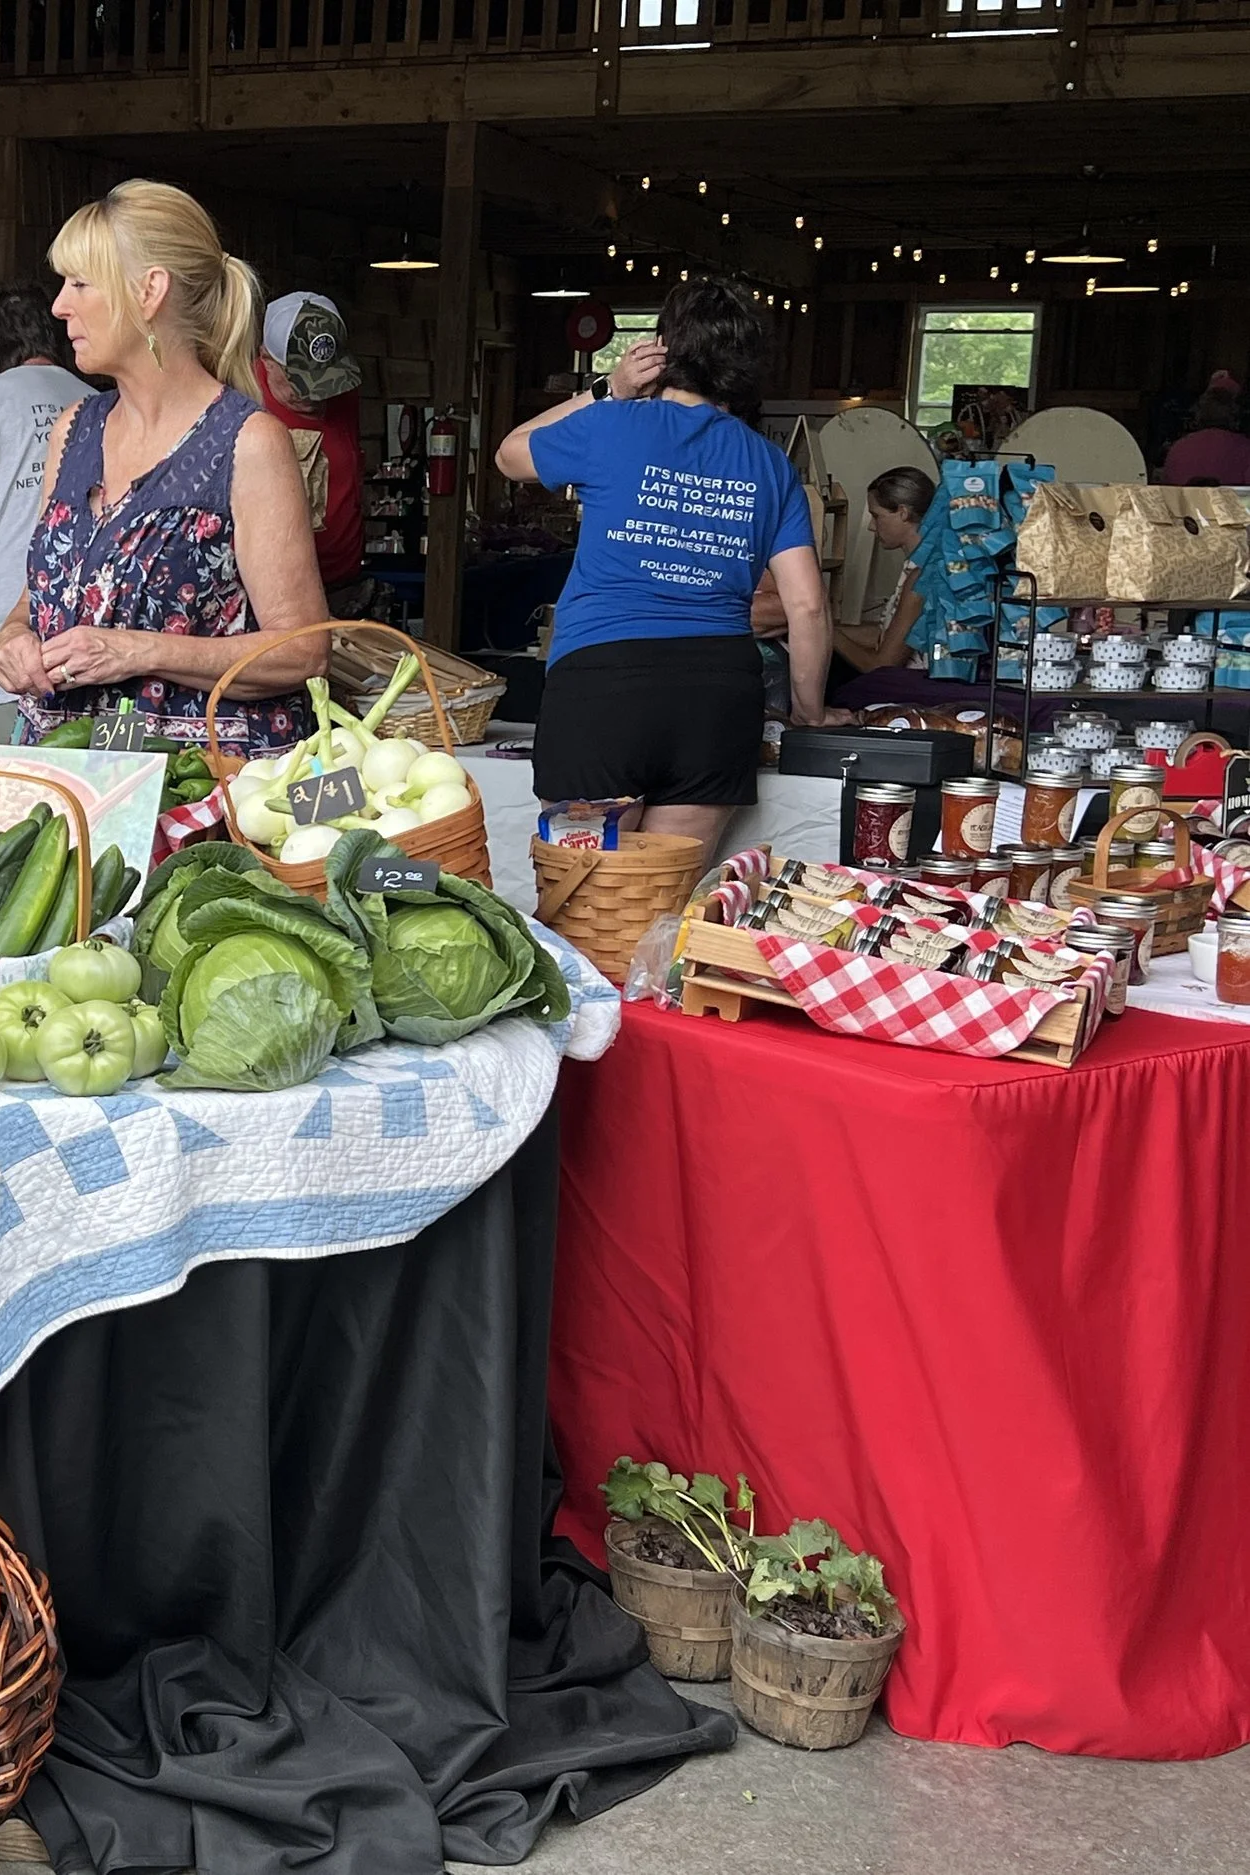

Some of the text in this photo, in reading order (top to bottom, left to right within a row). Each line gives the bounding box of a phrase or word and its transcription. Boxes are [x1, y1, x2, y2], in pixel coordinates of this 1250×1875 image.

[31, 404, 57, 414] IT'S
[644, 465, 757, 493] IT'S NEVER TOO
[641, 480, 755, 508] LATE TO CHASE
[637, 494, 754, 523] YOUR DREAMS!!
[607, 530, 653, 545] NEVER
[625, 519, 749, 548] BETTER LATE THAN
[640, 560, 690, 573] FOLLOW
[707, 570, 723, 580] ON
